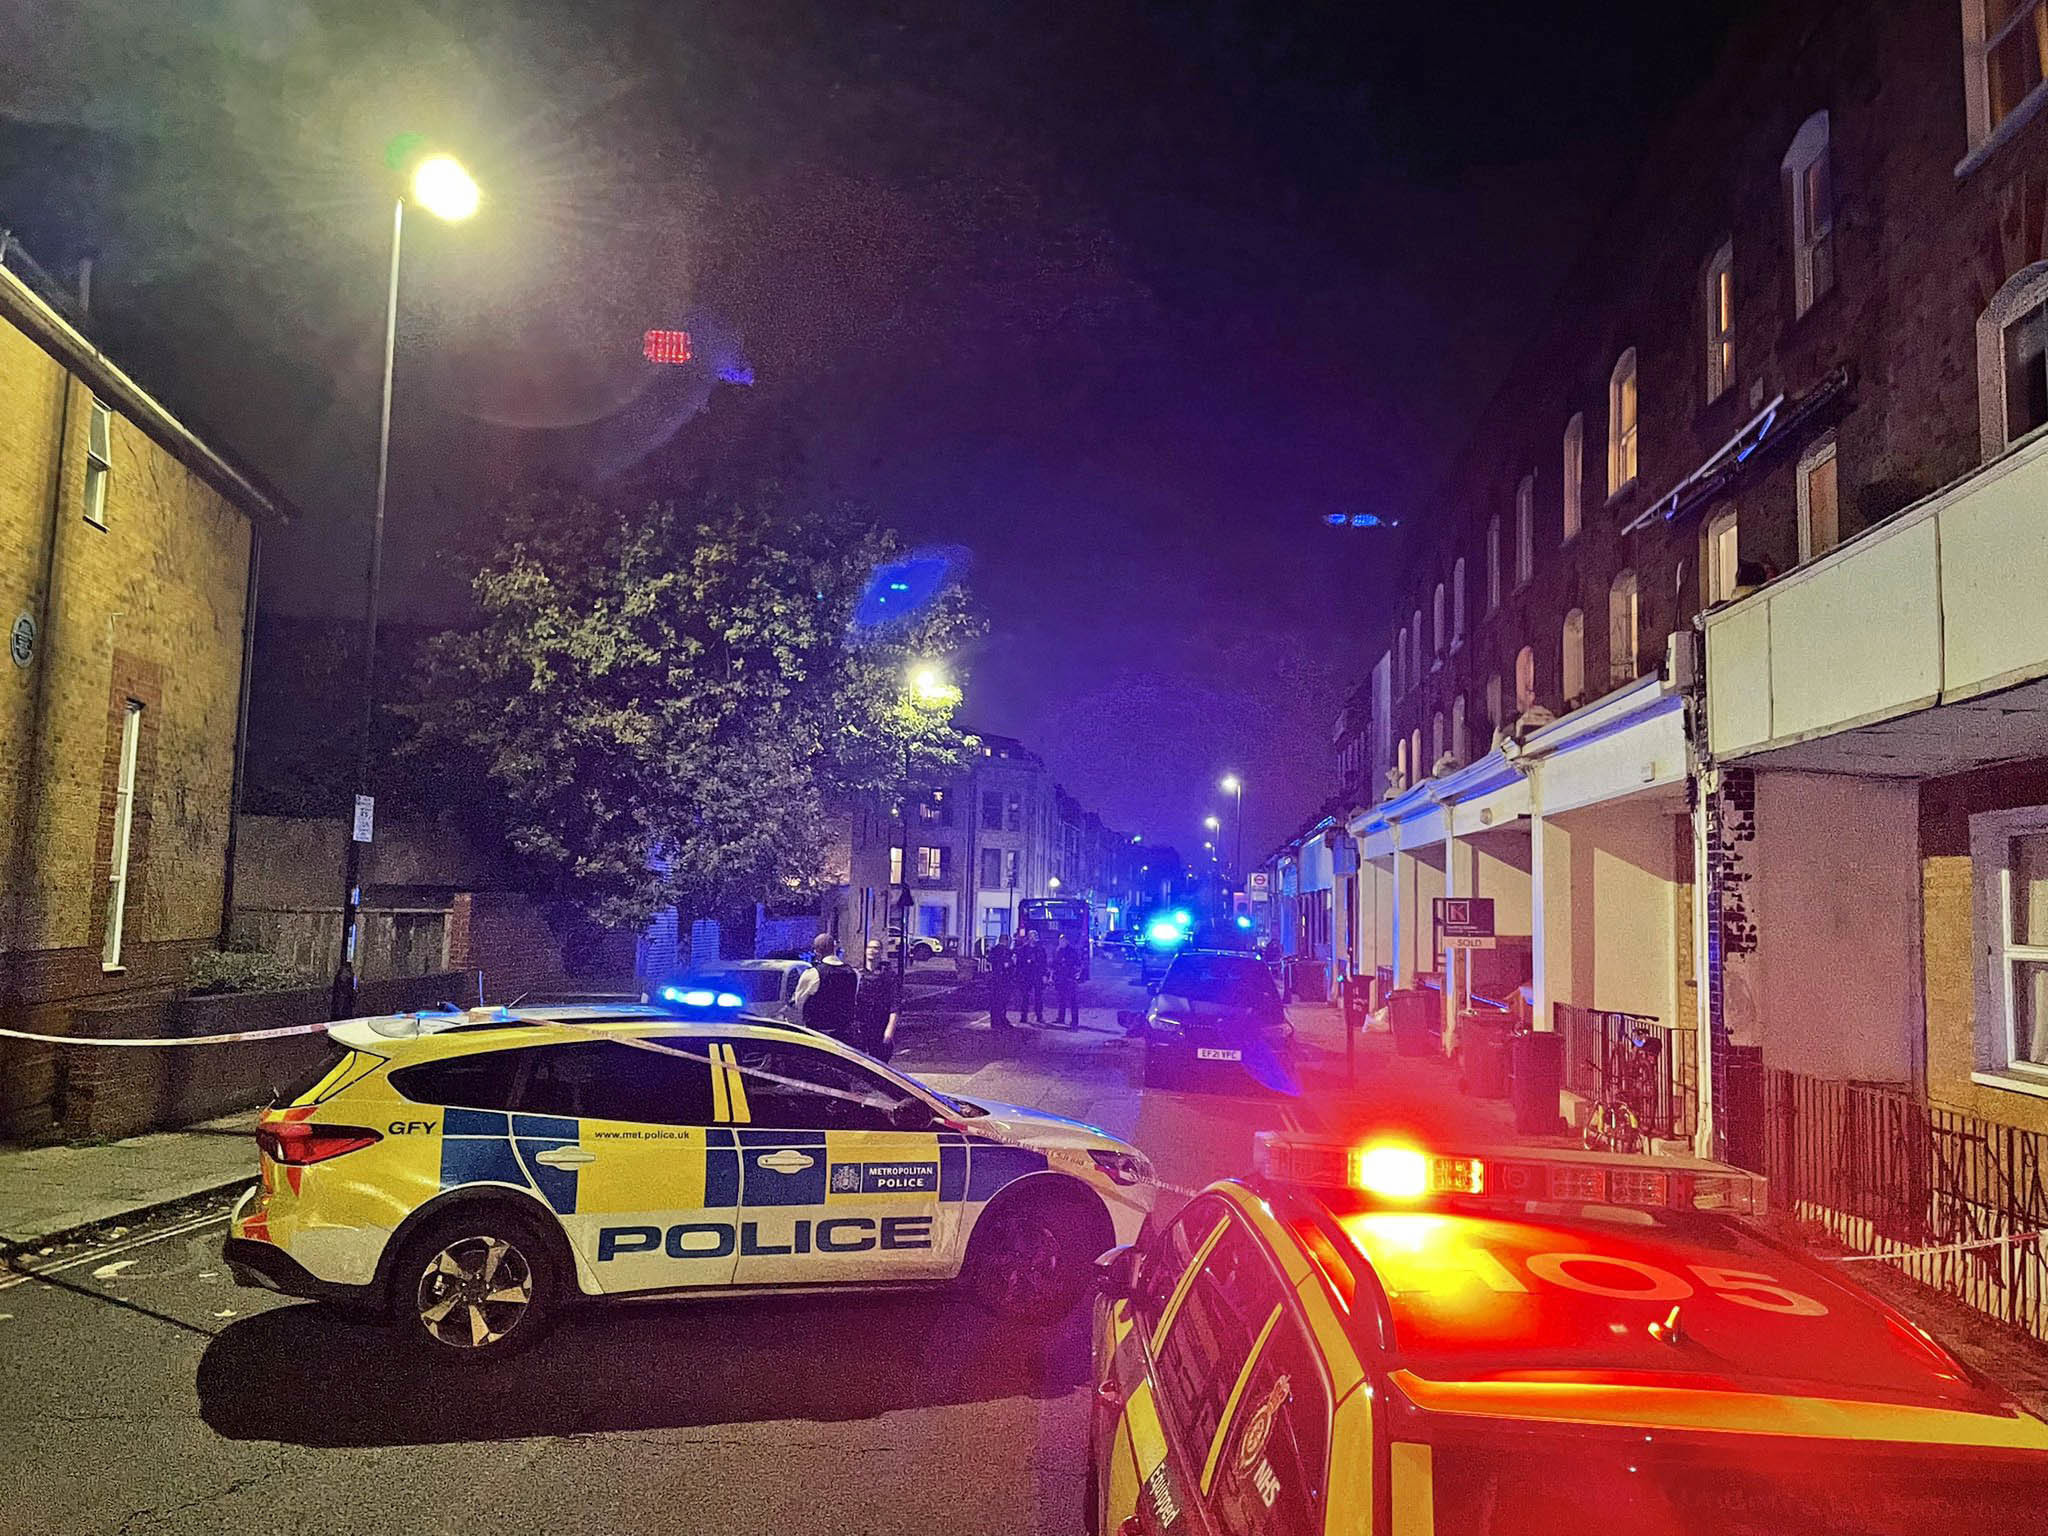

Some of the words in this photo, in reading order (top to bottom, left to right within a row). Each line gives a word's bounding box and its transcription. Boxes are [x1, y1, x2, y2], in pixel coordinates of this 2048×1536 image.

[1457, 938, 1481, 947] SOLD
[387, 1121, 437, 1135] GFY
[594, 1130, 690, 1141] www.met.police.uk
[868, 1167, 933, 1176] METROPOLITAN
[877, 1178, 925, 1188] POLICE
[597, 1216, 933, 1262] POLICE
[1253, 1458, 1280, 1508] NHS
[1149, 1462, 1180, 1529] Equipped
